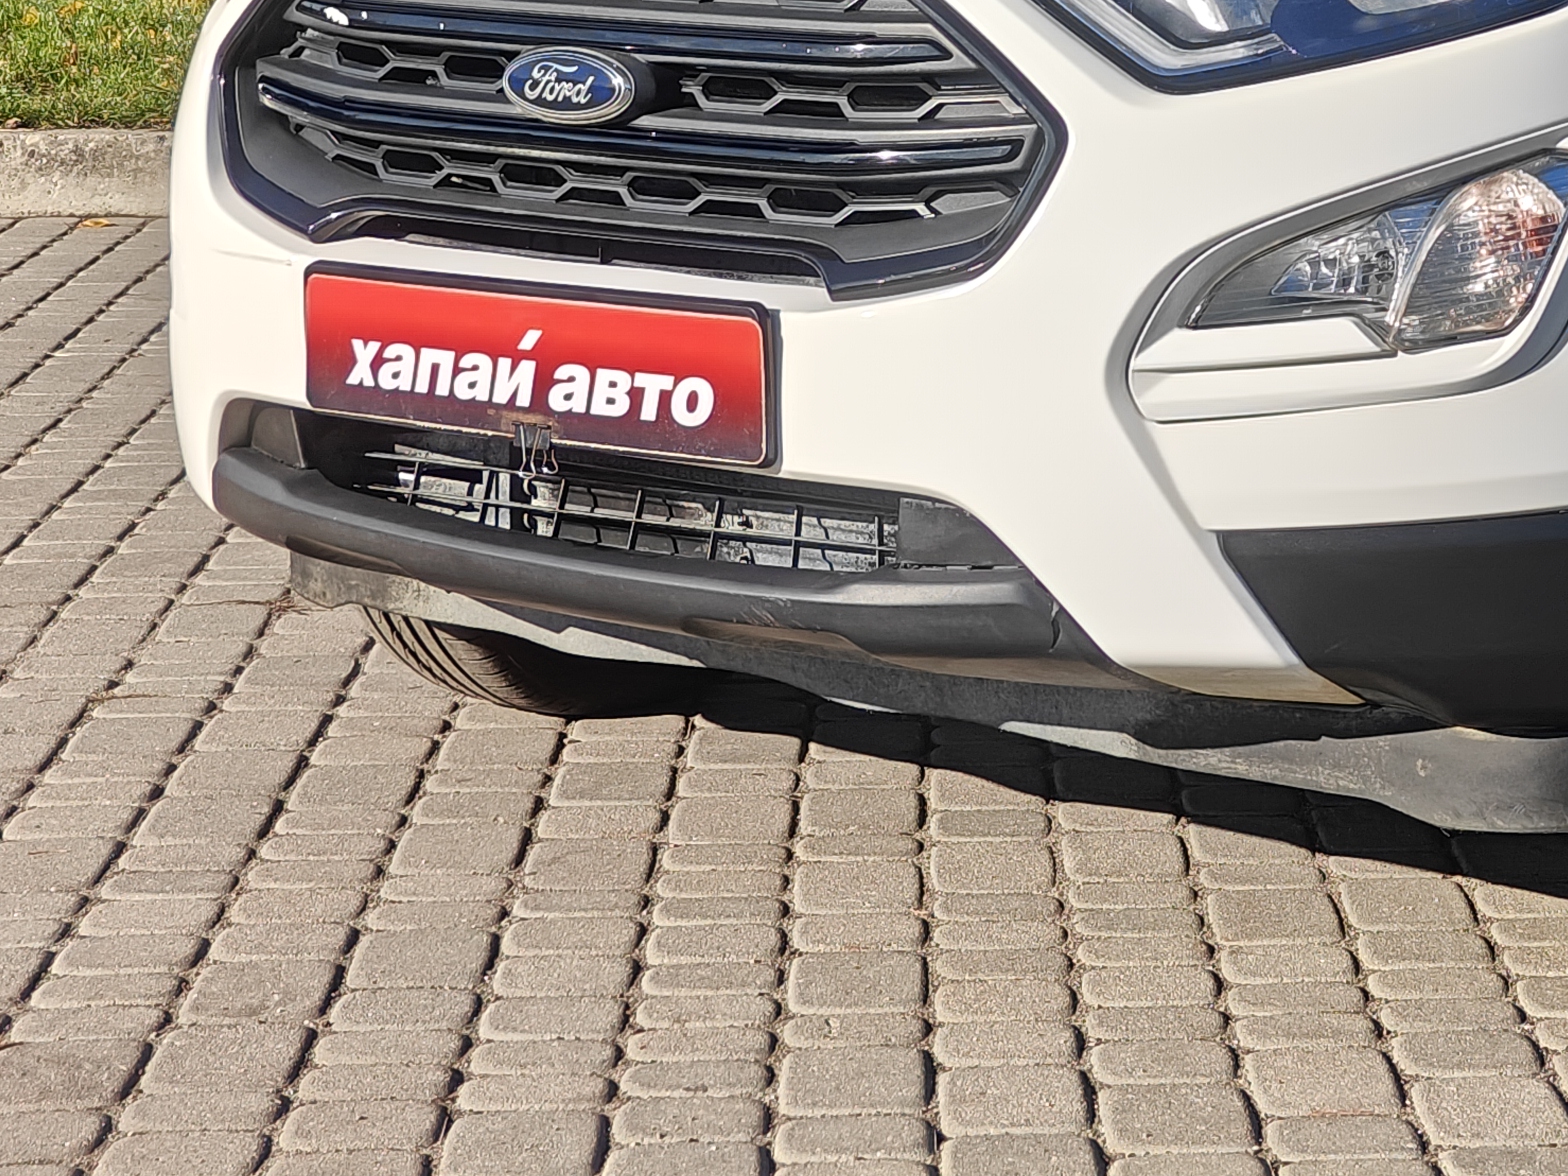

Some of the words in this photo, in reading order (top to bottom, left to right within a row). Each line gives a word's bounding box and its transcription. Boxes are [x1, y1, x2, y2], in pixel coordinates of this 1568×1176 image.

[523, 61, 595, 105] Ford
[346, 329, 544, 409] хапай
[547, 362, 715, 428] авто
